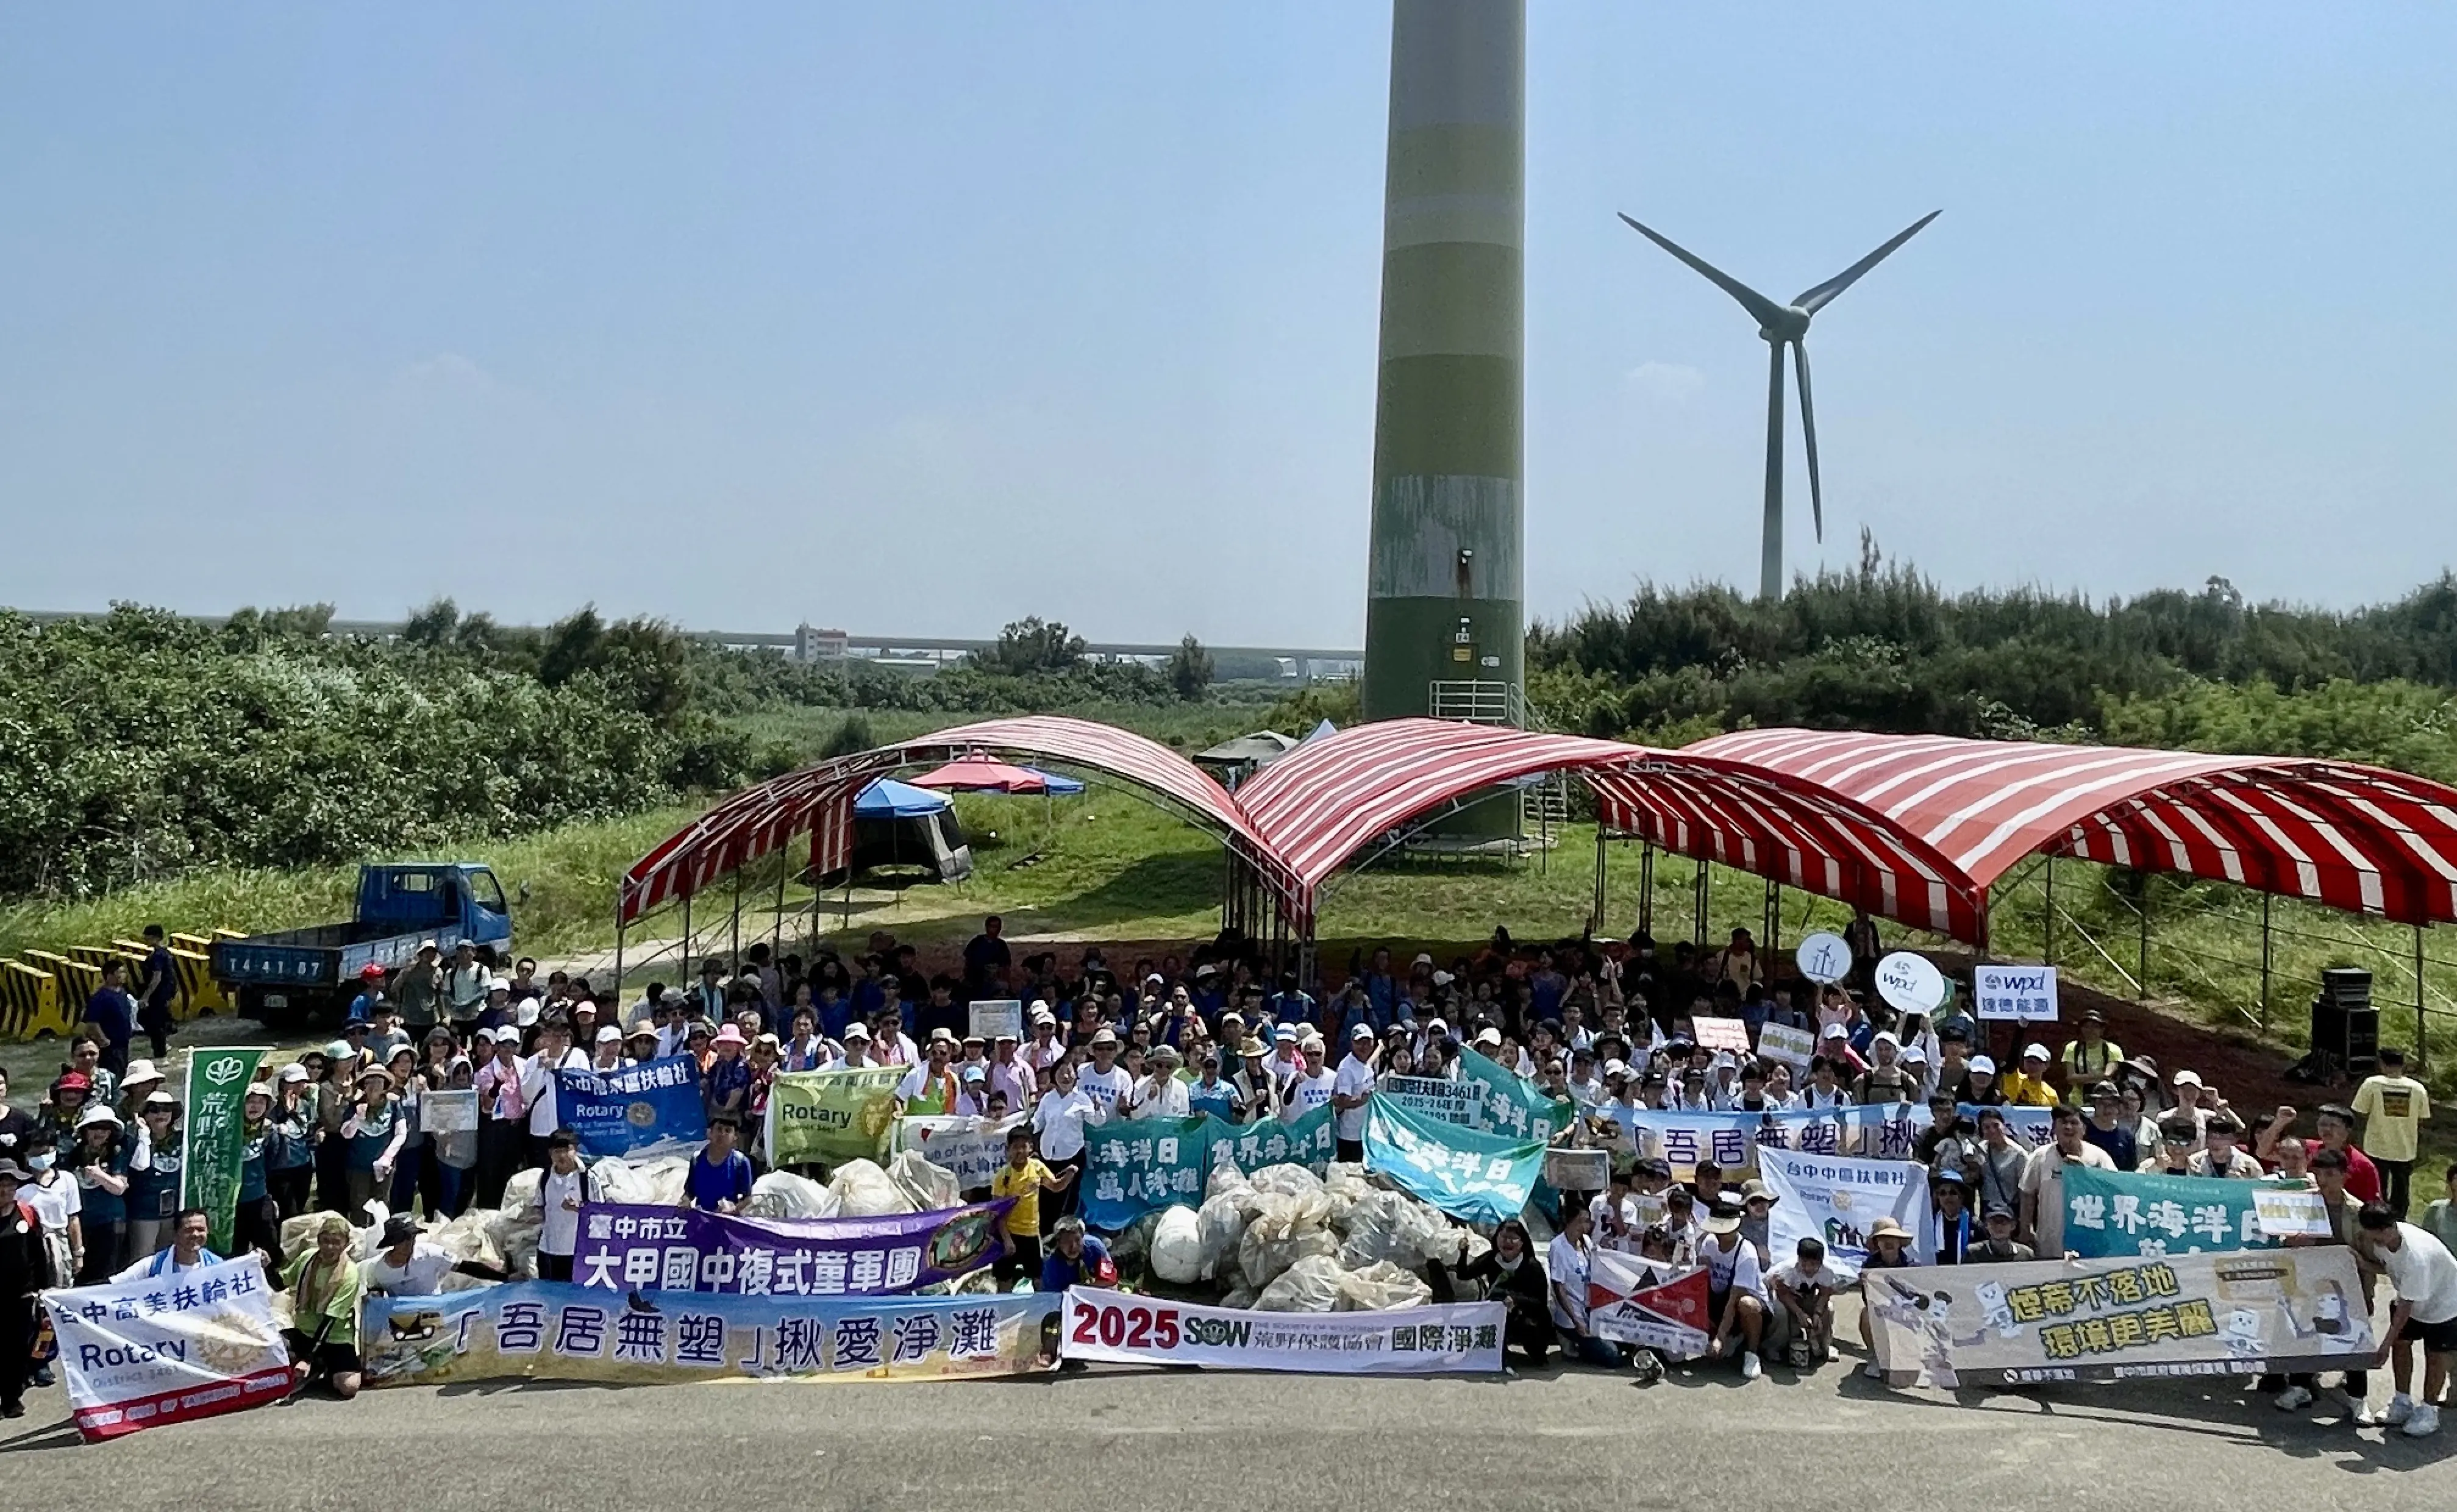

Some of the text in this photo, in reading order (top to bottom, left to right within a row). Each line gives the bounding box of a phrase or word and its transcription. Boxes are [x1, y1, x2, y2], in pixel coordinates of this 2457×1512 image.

[1883, 972, 1917, 993] wpd
[2003, 970, 2045, 996] wpd
[576, 1104, 624, 1119] Rotary
[782, 1103, 852, 1129] Rotary
[1787, 1161, 1905, 1185] 台中中區扶輪社
[588, 1214, 688, 1240] 臺中市立
[583, 1244, 922, 1296] 大甲國中複式童軍團
[54, 1269, 257, 1324] 台中高美扶輪社
[2005, 1261, 2180, 1323] 煙蒂不落地
[455, 1302, 999, 1369] 「吾居無塑」揪愛淨灘
[1072, 1303, 1180, 1350] 2025
[1183, 1316, 1253, 1348] SOW
[1392, 1324, 1497, 1353] 國際淨灘
[2038, 1298, 2219, 1360] 環境更美麗
[79, 1339, 186, 1371] Rotary
